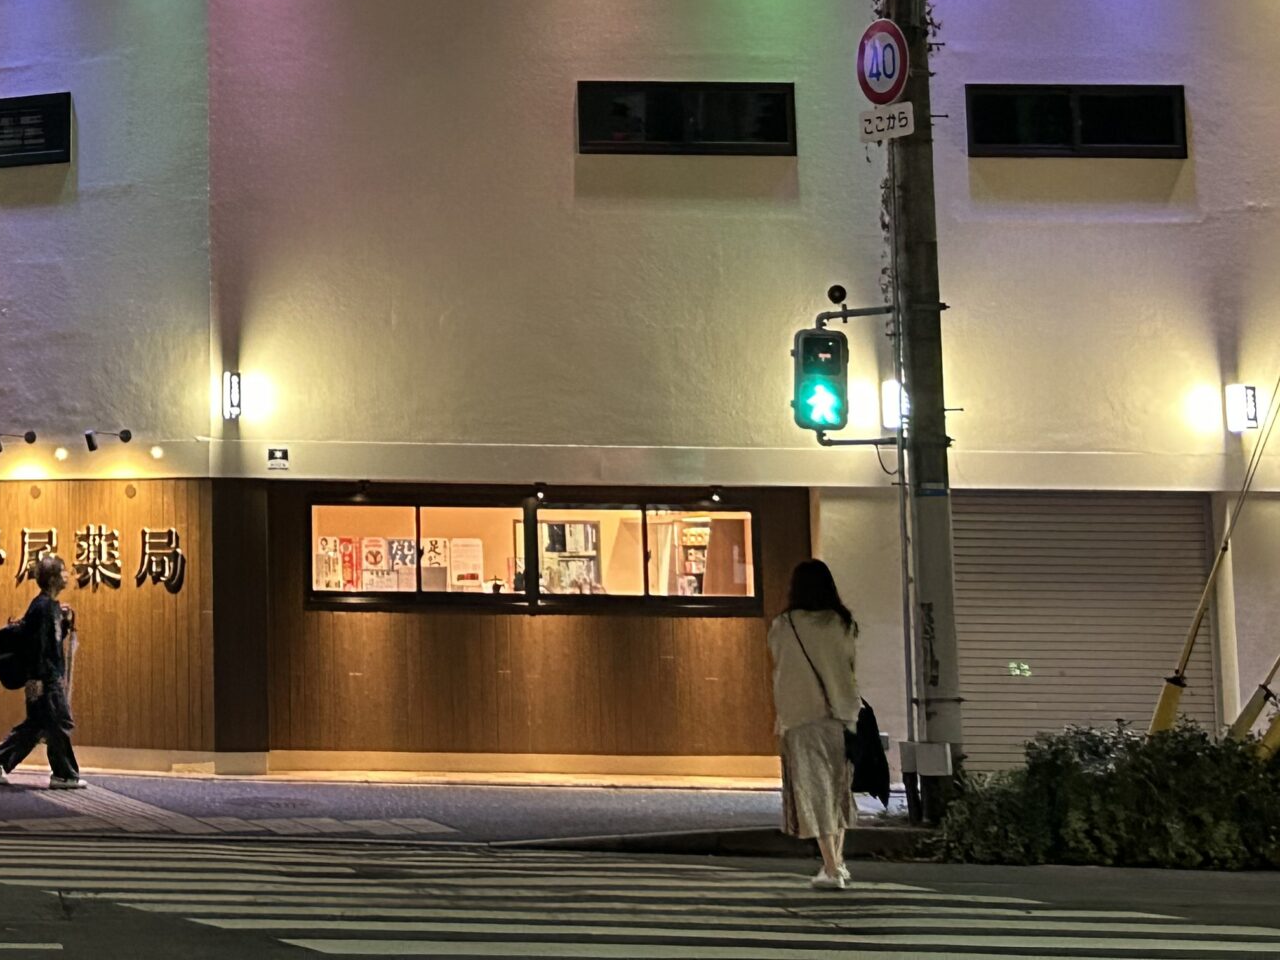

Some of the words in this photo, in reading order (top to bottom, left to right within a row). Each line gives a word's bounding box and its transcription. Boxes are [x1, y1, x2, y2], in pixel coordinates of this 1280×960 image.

[868, 41, 895, 81] 40
[864, 111, 908, 134] ここから
